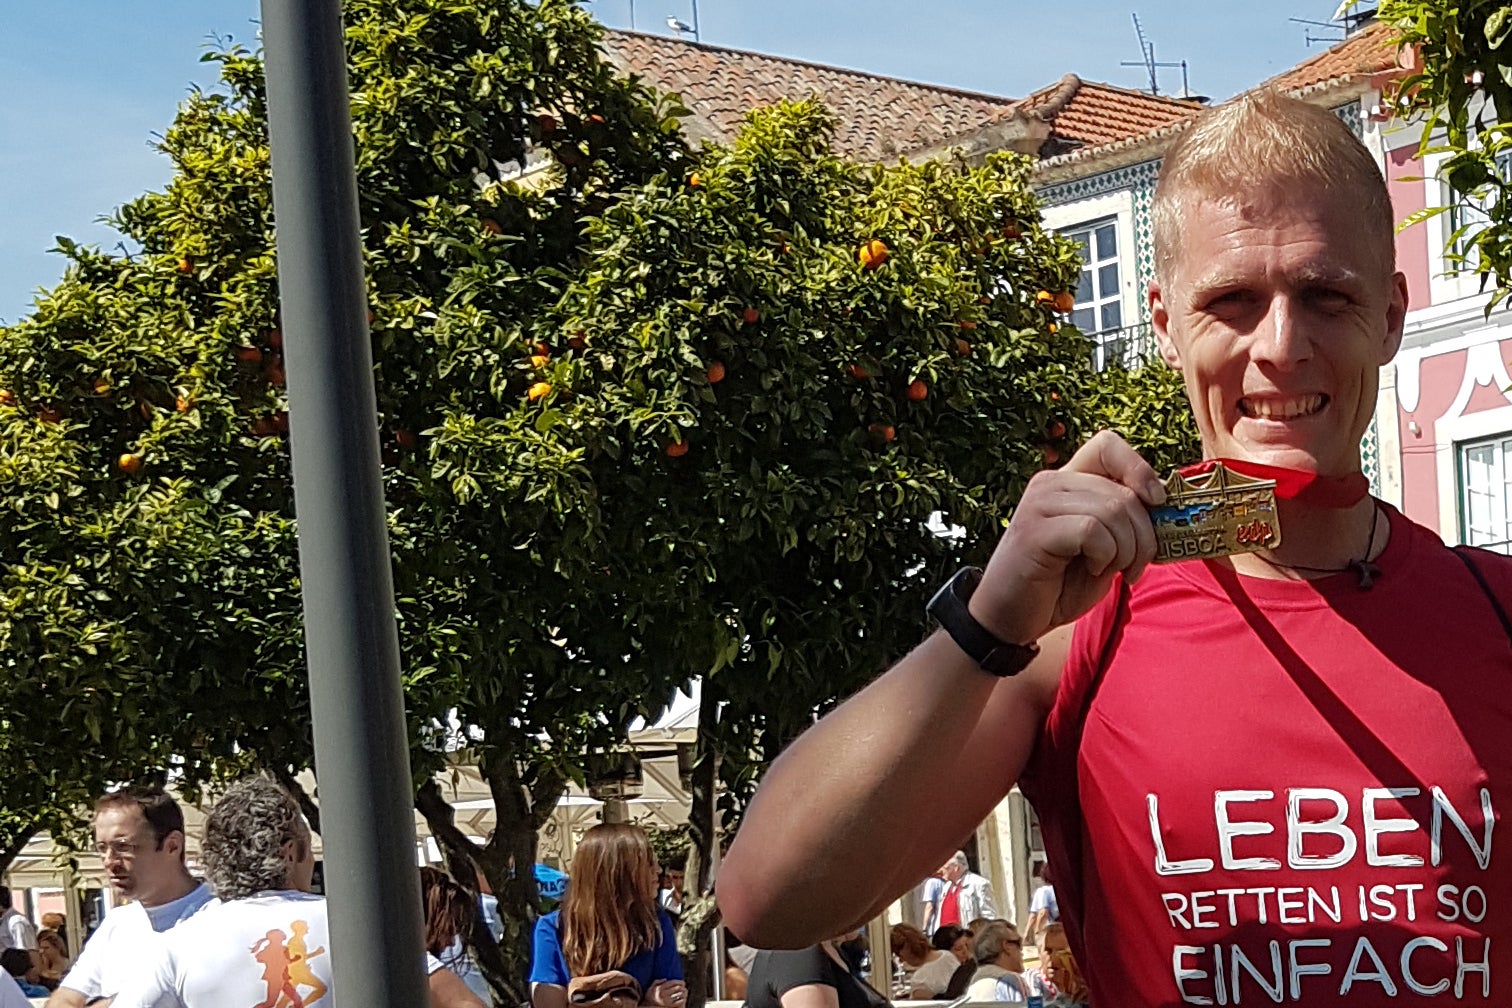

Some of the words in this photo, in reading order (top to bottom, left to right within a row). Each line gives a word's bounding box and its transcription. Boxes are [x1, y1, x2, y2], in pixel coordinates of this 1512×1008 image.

[1236, 518, 1273, 545] edp
[1146, 785, 1495, 876] LEBEN
[1161, 885, 1341, 930] RETTEN
[1358, 883, 1424, 922] IST
[1437, 884, 1487, 923] SO
[1173, 936, 1491, 1006] EINFACH
